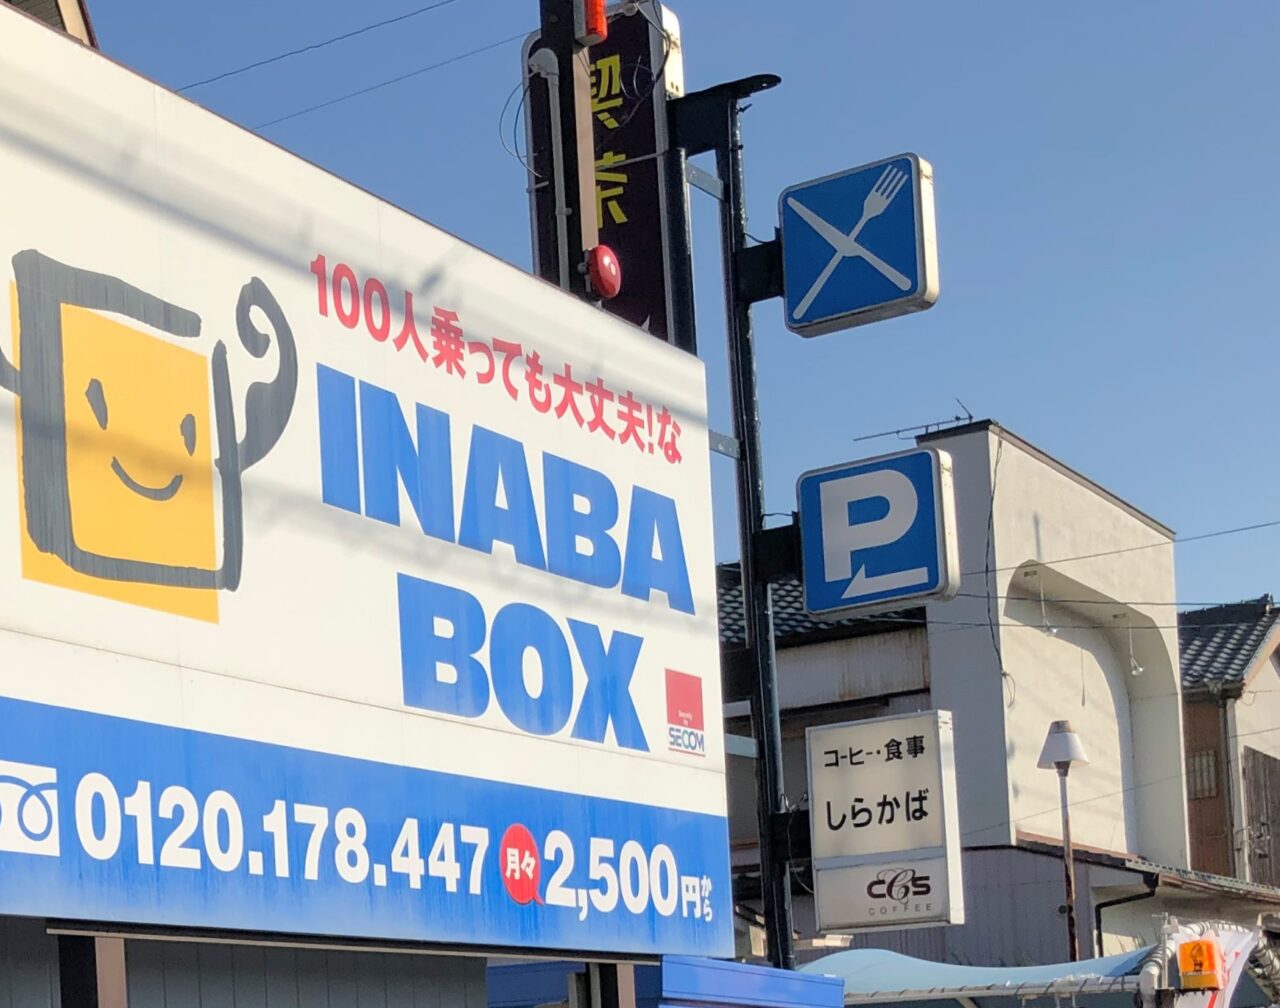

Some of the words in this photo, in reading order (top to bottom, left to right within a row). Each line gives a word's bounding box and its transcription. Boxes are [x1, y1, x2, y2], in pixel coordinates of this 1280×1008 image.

[316, 361, 696, 616] INABA
[821, 469, 918, 584] P
[396, 571, 651, 753] BOX
[668, 726, 705, 753] SECOM
[75, 772, 490, 897] 0120.178.447
[826, 787, 930, 831] しらかば
[504, 847, 537, 882] 月々
[868, 903, 932, 916] COFFEE
